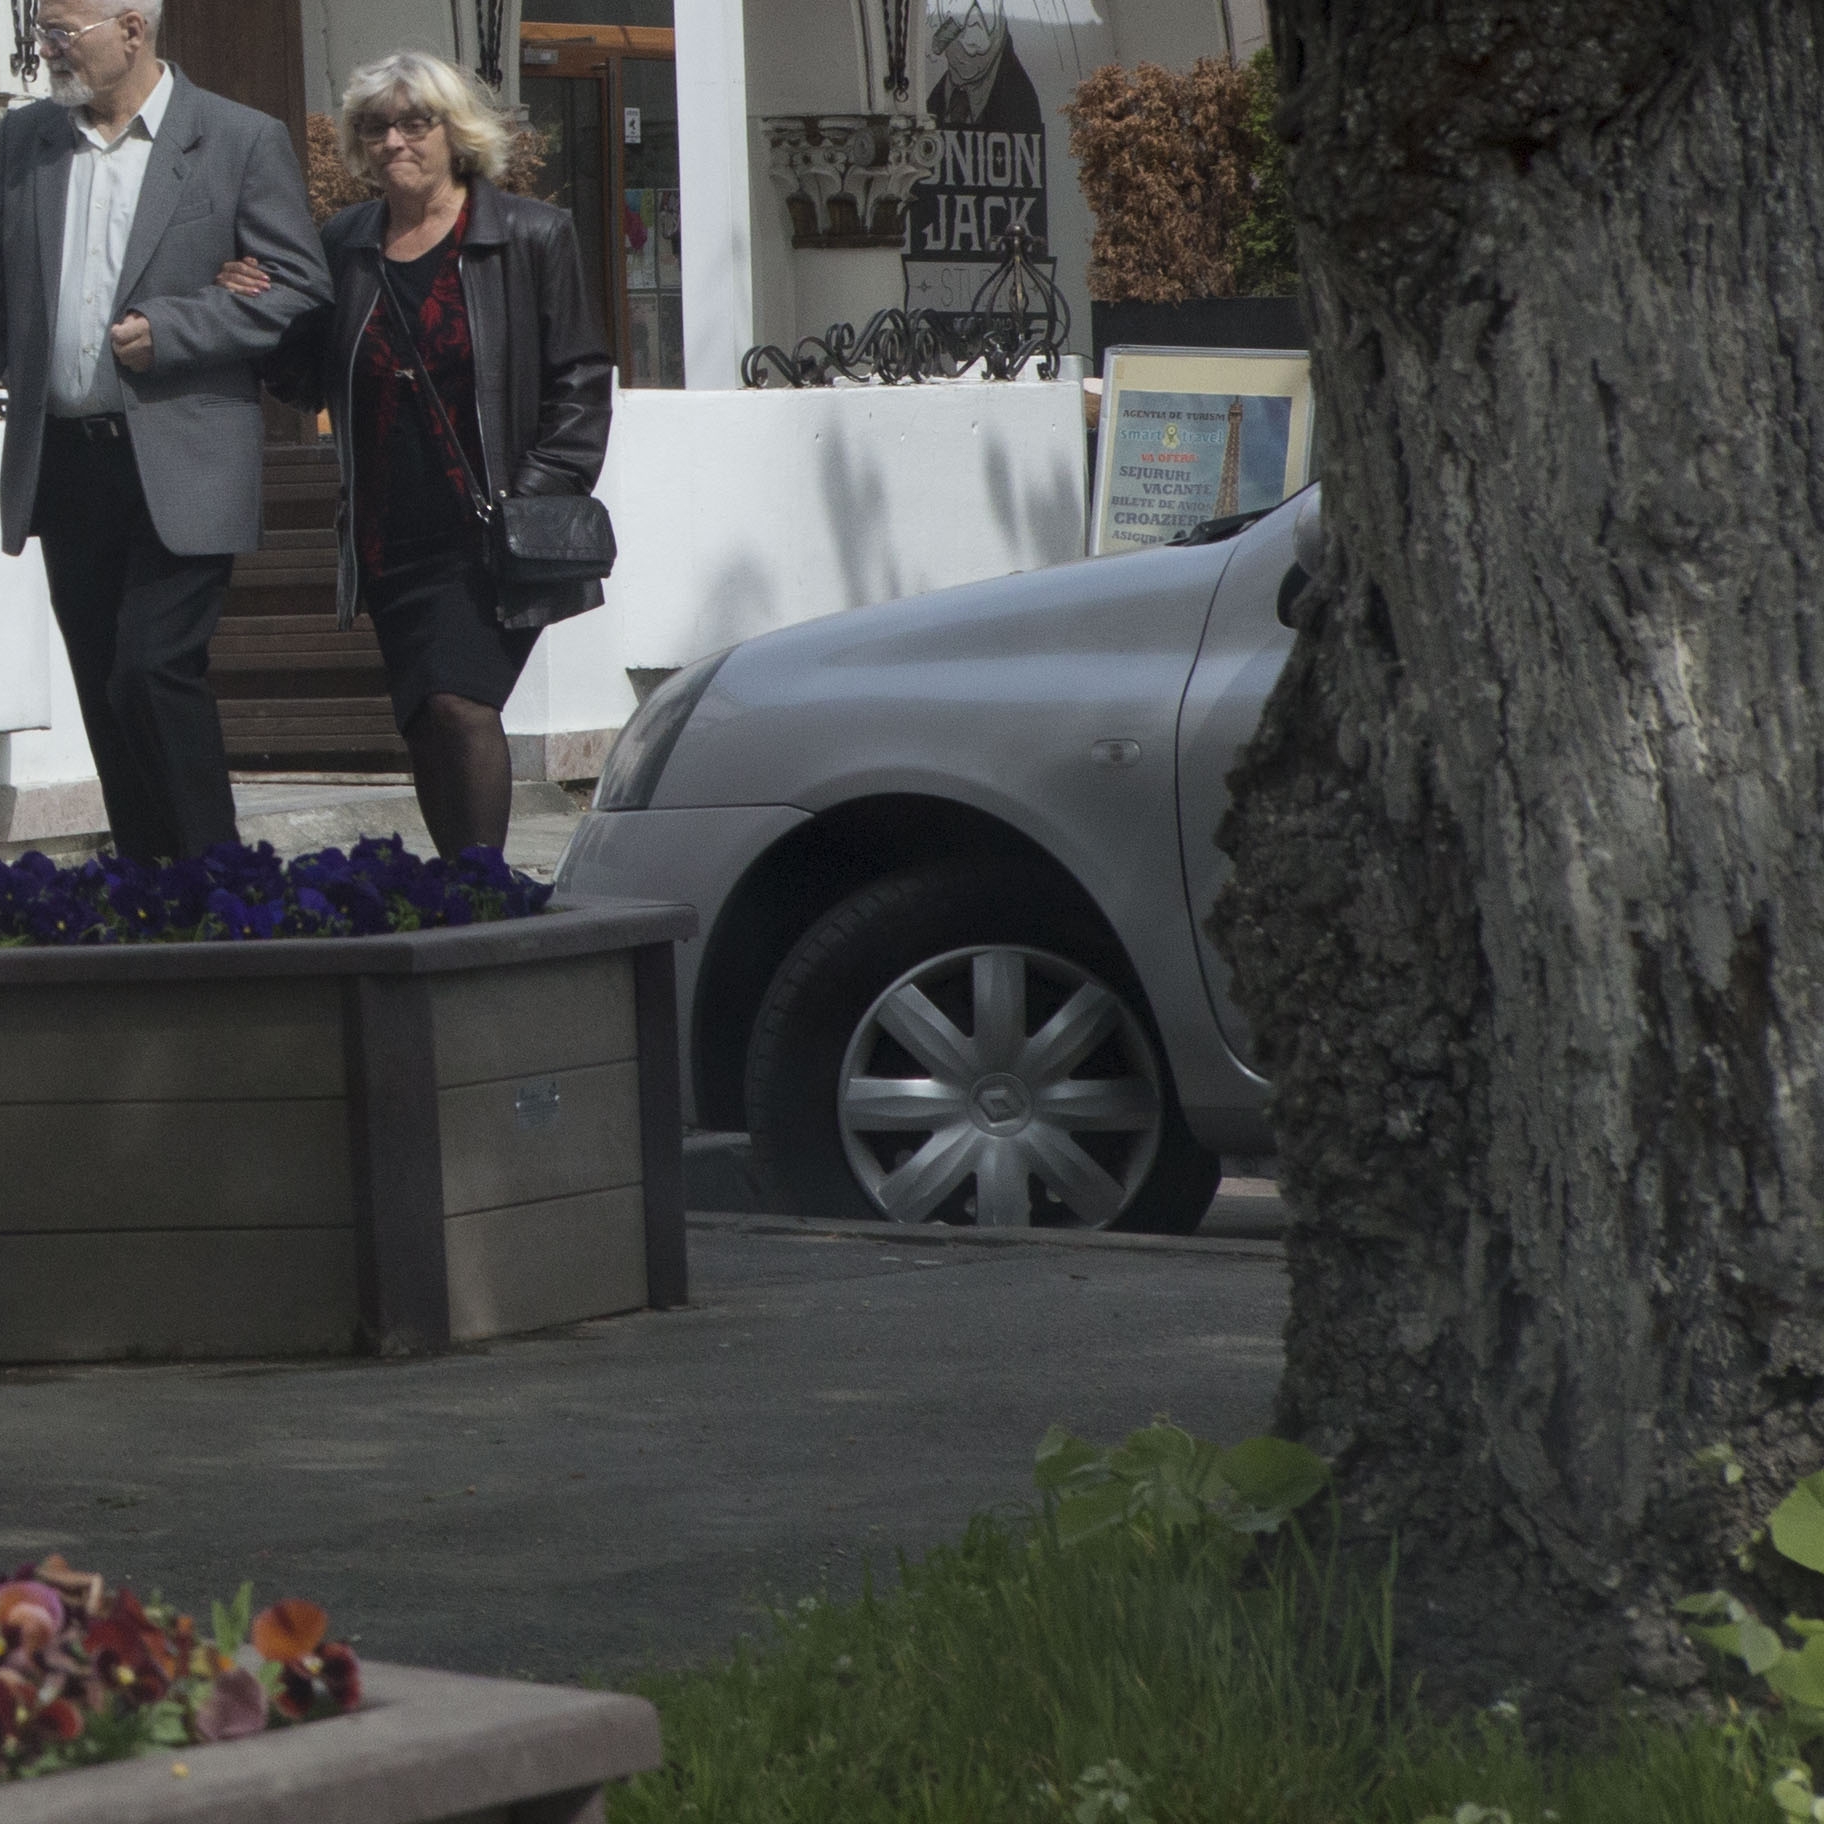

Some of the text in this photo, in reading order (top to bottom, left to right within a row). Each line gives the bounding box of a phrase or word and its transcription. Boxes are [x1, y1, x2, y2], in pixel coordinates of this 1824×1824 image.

[1168, 410, 1183, 420] DE
[1187, 412, 1225, 422] TURISM
[1120, 428, 1224, 444] smart travel
[1119, 465, 1192, 482] SEJURURI
[1142, 483, 1213, 496] VACANTE
[1111, 495, 1156, 509] BILETE
[1158, 498, 1176, 509] DE
